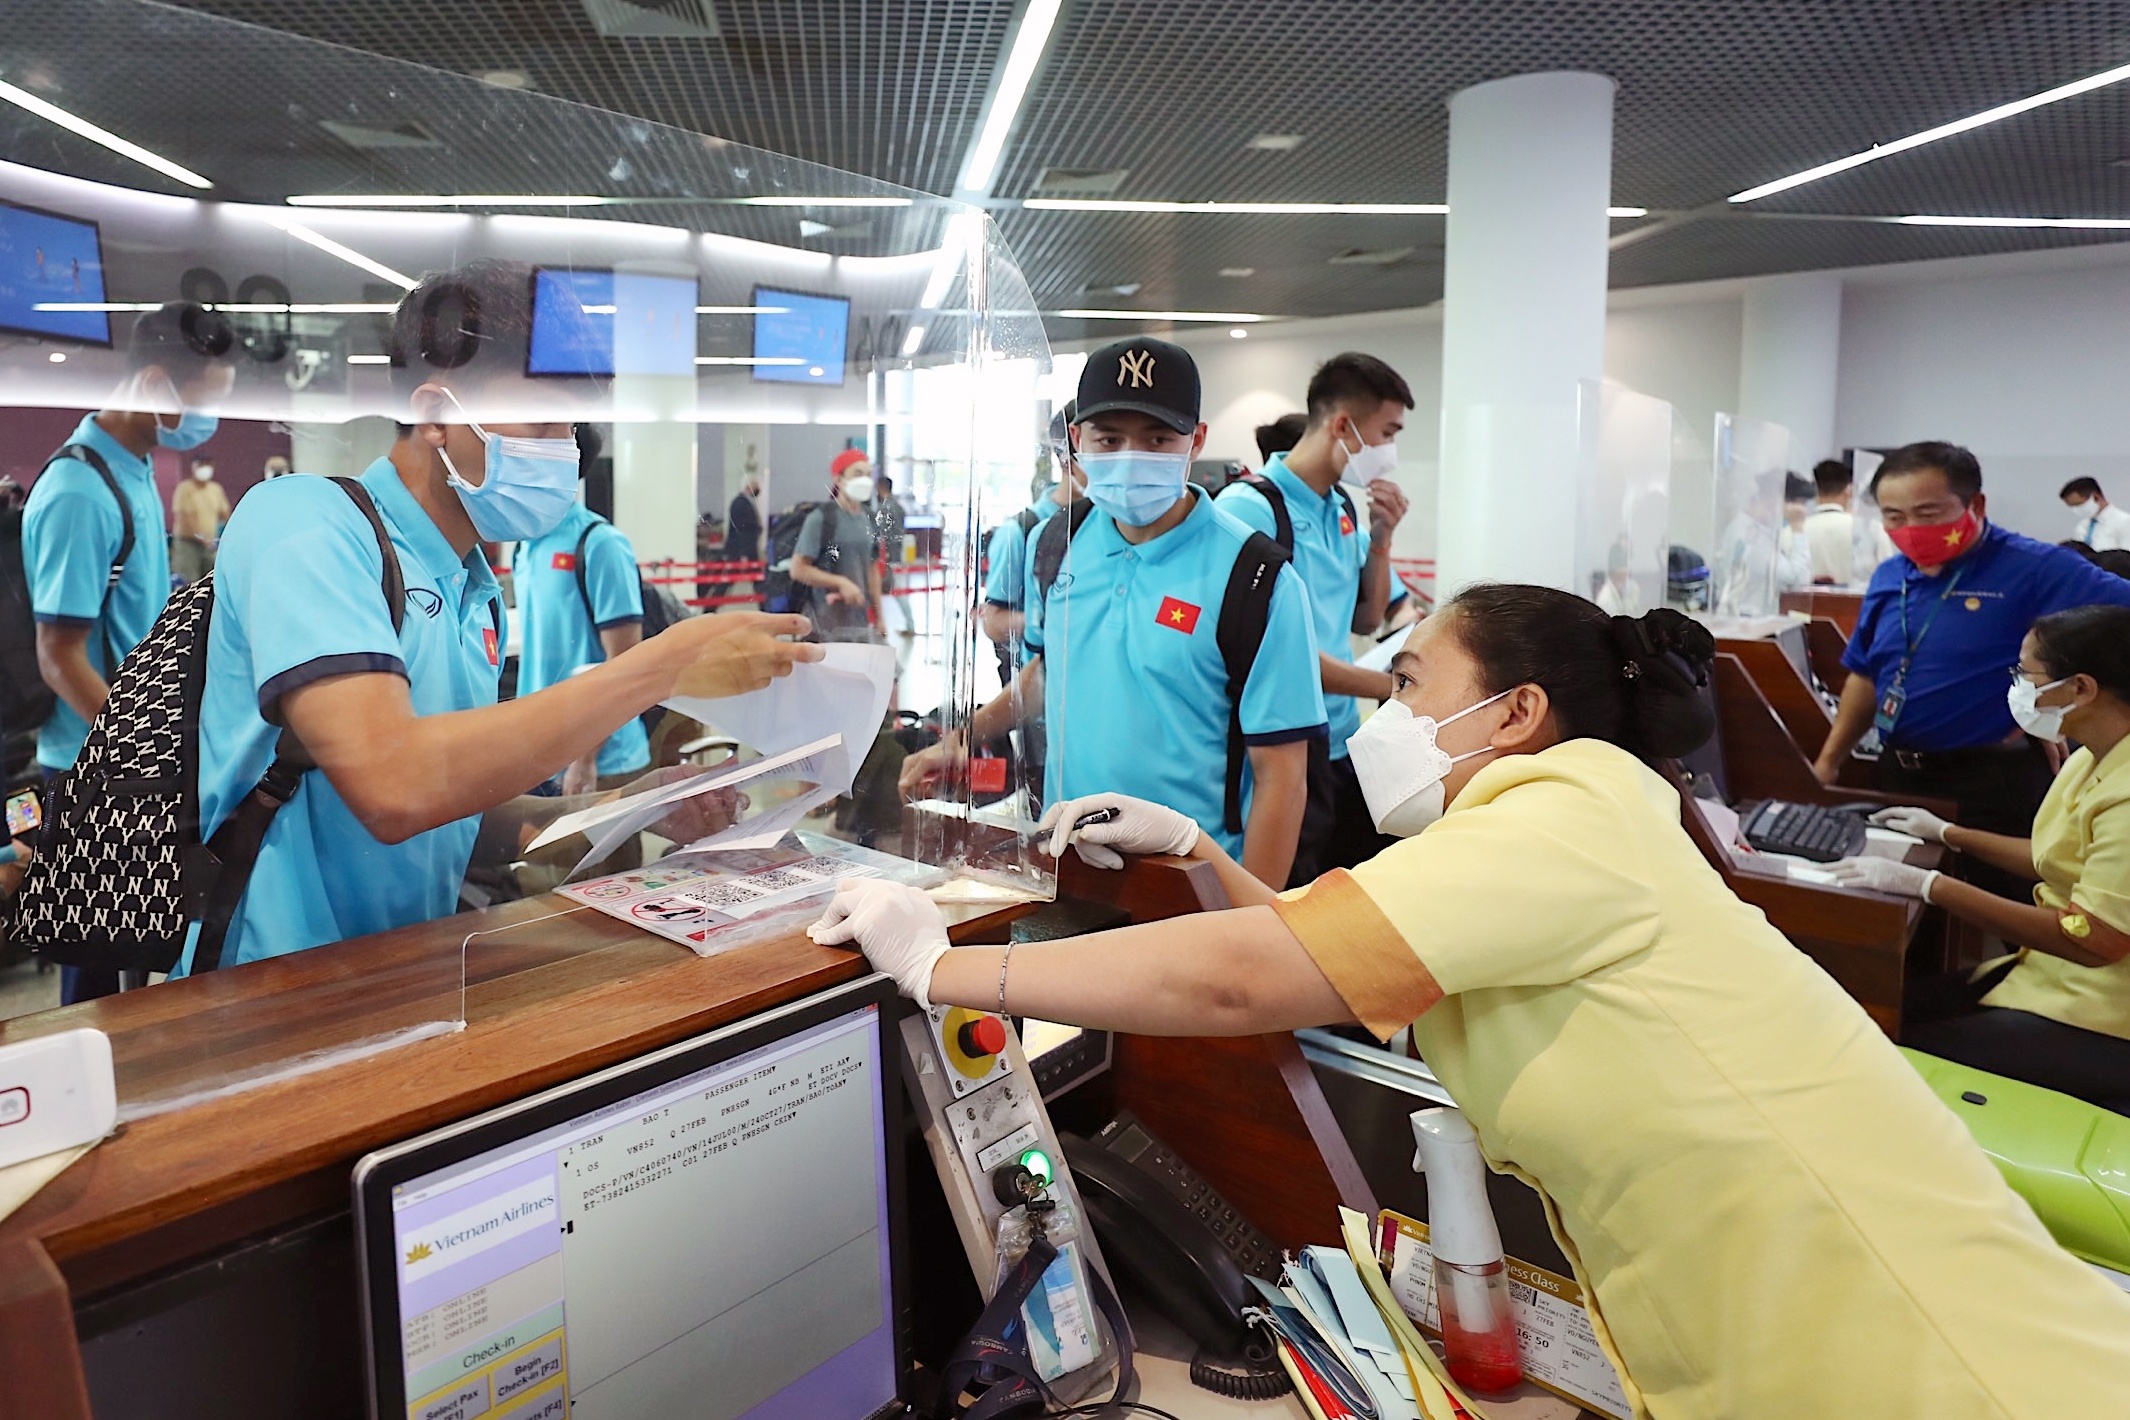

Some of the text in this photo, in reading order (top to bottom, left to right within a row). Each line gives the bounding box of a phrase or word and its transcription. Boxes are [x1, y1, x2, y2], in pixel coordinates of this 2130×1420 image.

[1117, 349, 1156, 388] NY
[808, 1080, 818, 1091] ET
[841, 1064, 859, 1077] DOCS
[580, 1135, 604, 1151] TRAN
[642, 1112, 659, 1126] BAO
[704, 1076, 749, 1101] PASSENGER
[753, 1067, 773, 1082] ITEM
[626, 1138, 655, 1156] VN852
[680, 1116, 707, 1134] 27FEB
[702, 1140, 728, 1159] 27FEB
[773, 1113, 793, 1127] CKIN
[435, 1195, 555, 1252] Vietnam Airlines
[1530, 1271, 1560, 1293] Class
[1535, 1314, 1555, 1328] 27FEB
[463, 1335, 516, 1369] Check-in
[1535, 1336, 1550, 1349] 50
[497, 1358, 559, 1397] Check-in [F2]
[514, 1356, 542, 1377] Begin
[426, 1389, 479, 1420] Select Pax
